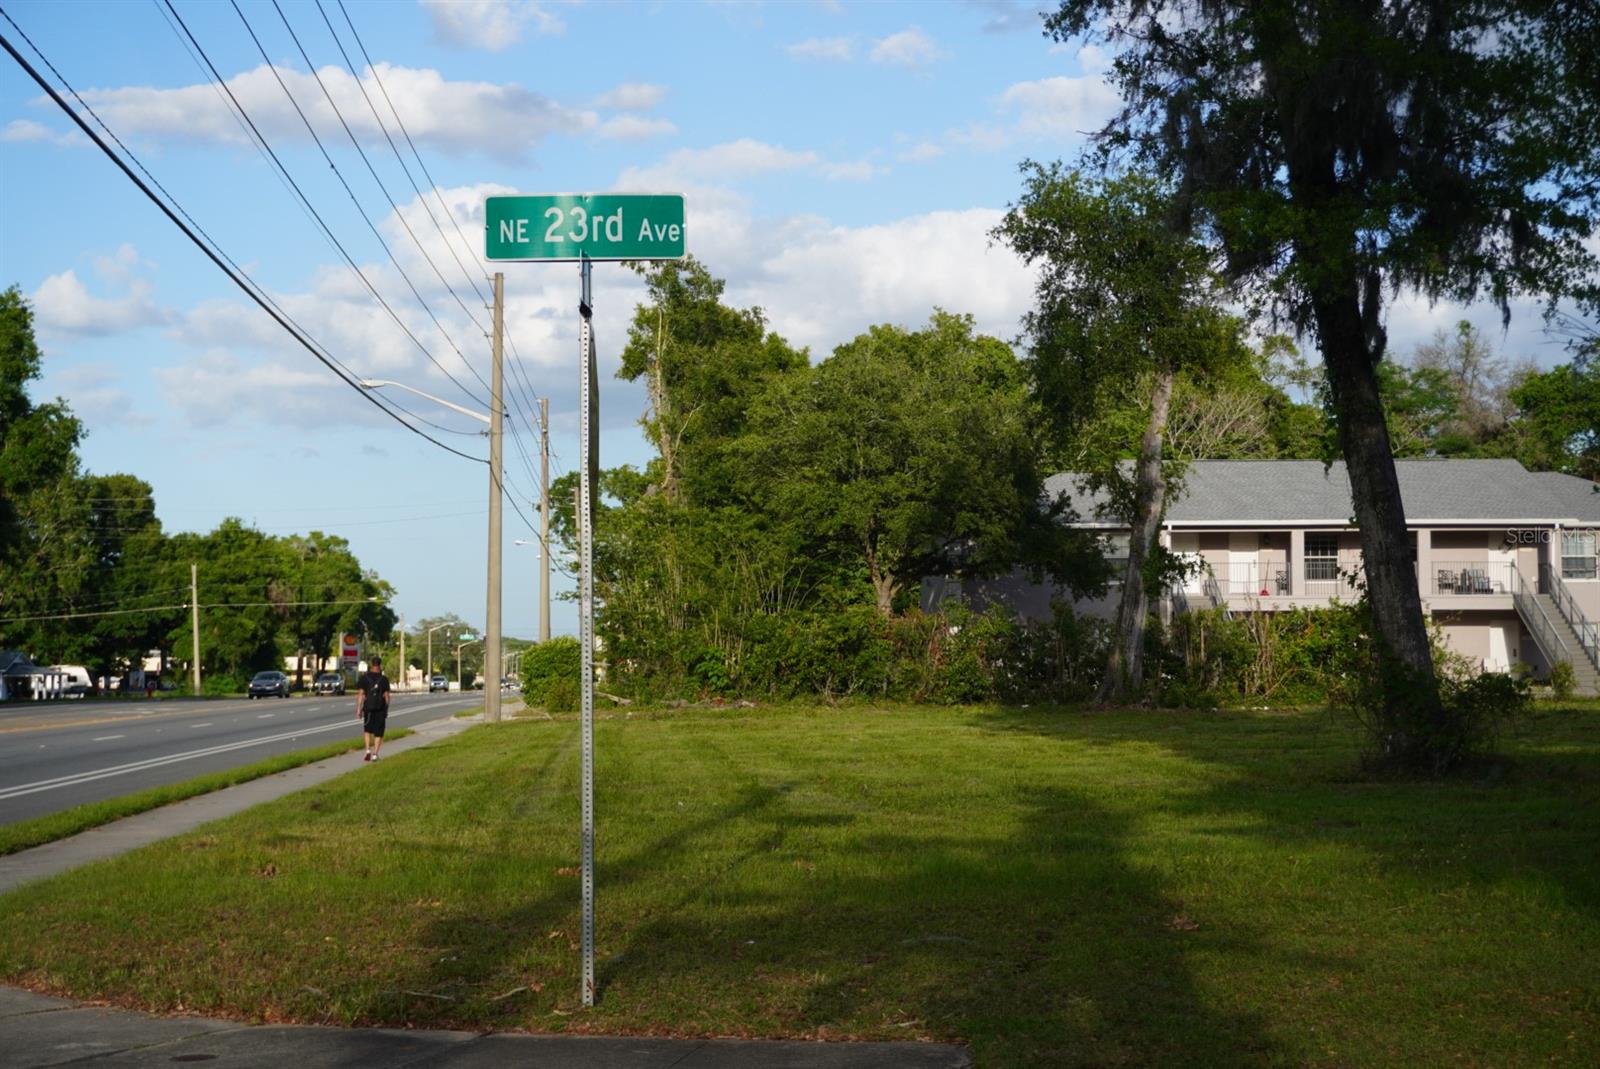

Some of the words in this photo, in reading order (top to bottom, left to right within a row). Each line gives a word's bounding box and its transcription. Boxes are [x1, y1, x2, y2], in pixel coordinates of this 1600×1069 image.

[500, 219, 530, 243] NE
[544, 206, 623, 243] 23rd
[637, 217, 680, 242] Ave
